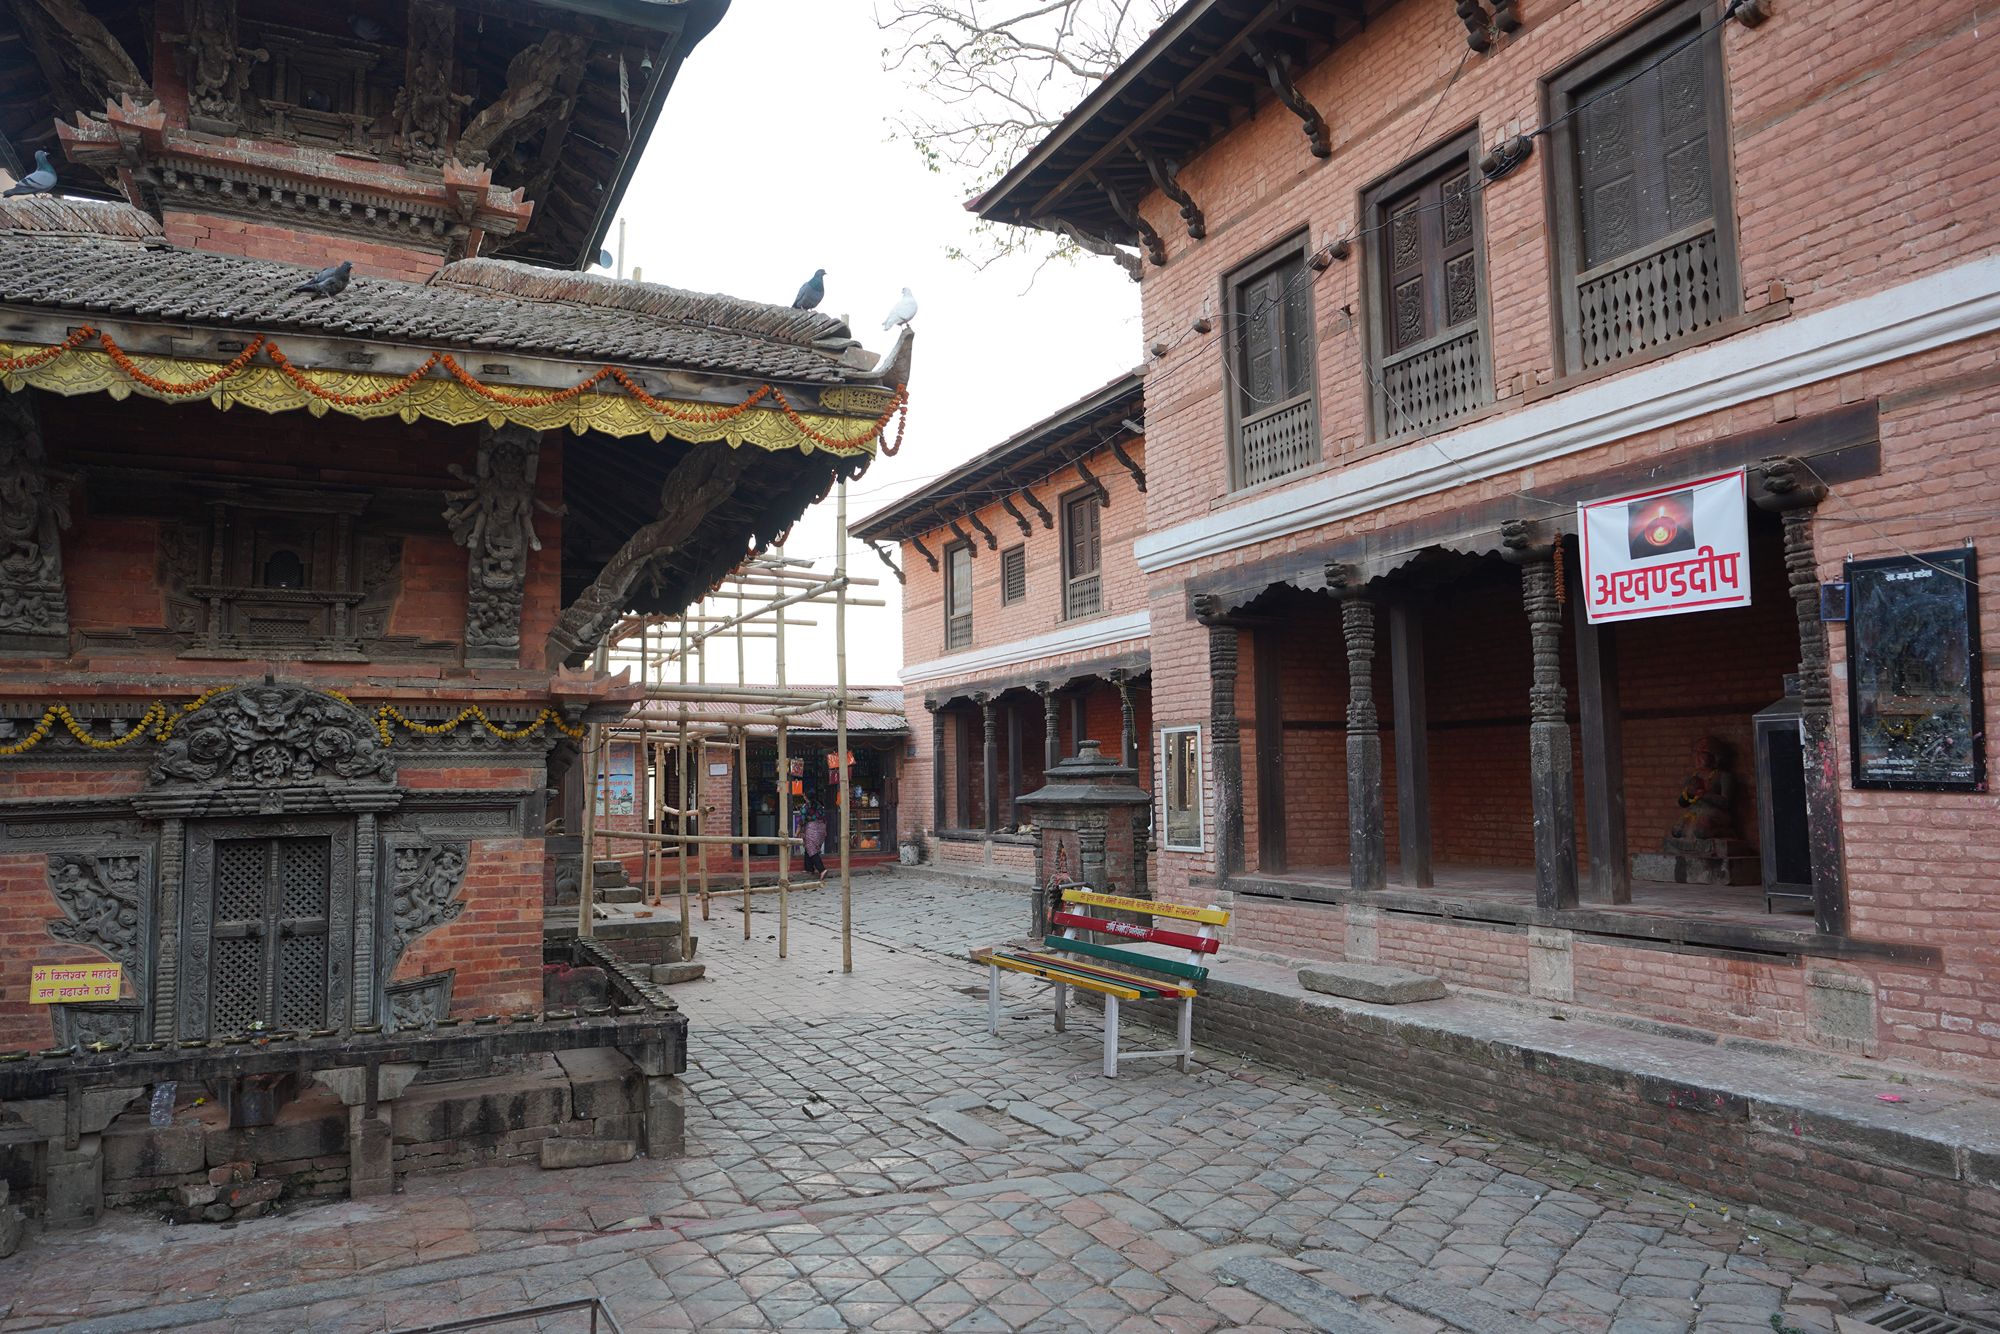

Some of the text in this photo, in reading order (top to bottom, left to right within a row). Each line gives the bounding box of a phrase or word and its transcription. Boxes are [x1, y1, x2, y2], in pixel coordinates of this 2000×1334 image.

[1595, 545, 1741, 605] अखण्डदीप
[34, 969, 46, 981] श्री
[91, 967, 119, 980] महादेव
[38, 988, 54, 998] जल
[94, 983, 111, 995] ठाउँ
